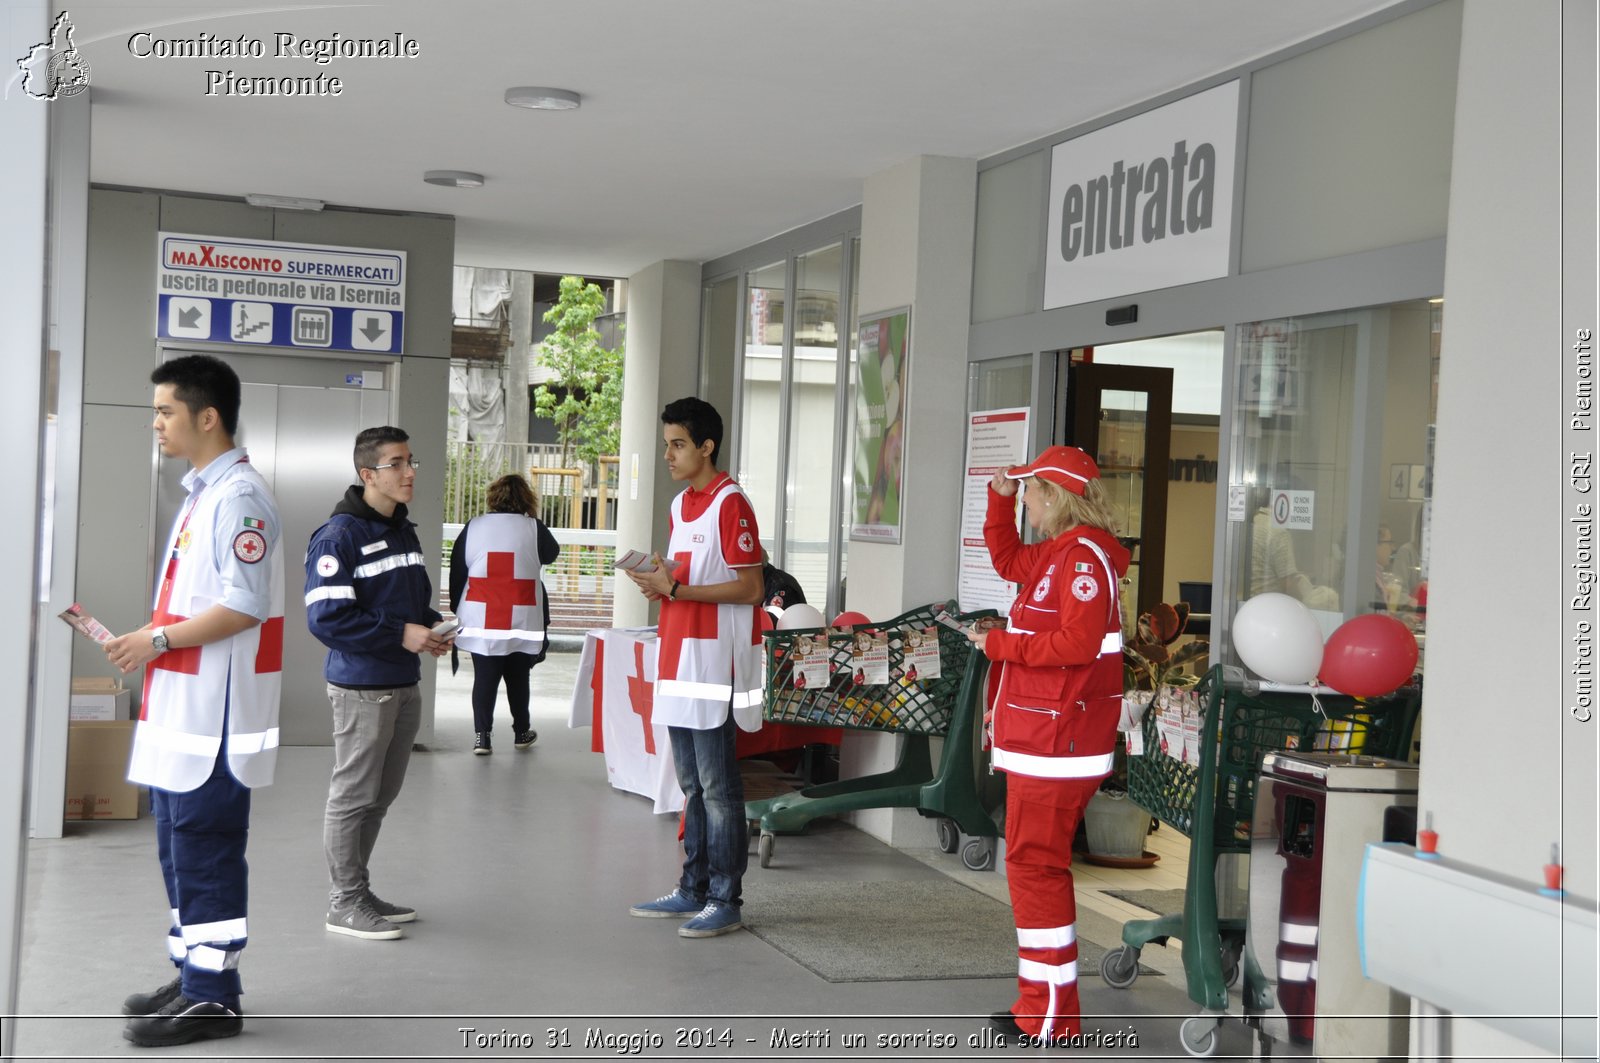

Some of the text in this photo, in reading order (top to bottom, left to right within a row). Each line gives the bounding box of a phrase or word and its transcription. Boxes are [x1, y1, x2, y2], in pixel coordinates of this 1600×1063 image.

[1060, 139, 1216, 263] entrata
[171, 245, 394, 281] MAXISCONTO SUPERMERCATI
[162, 273, 401, 306] uscita pedonale via Isernia
